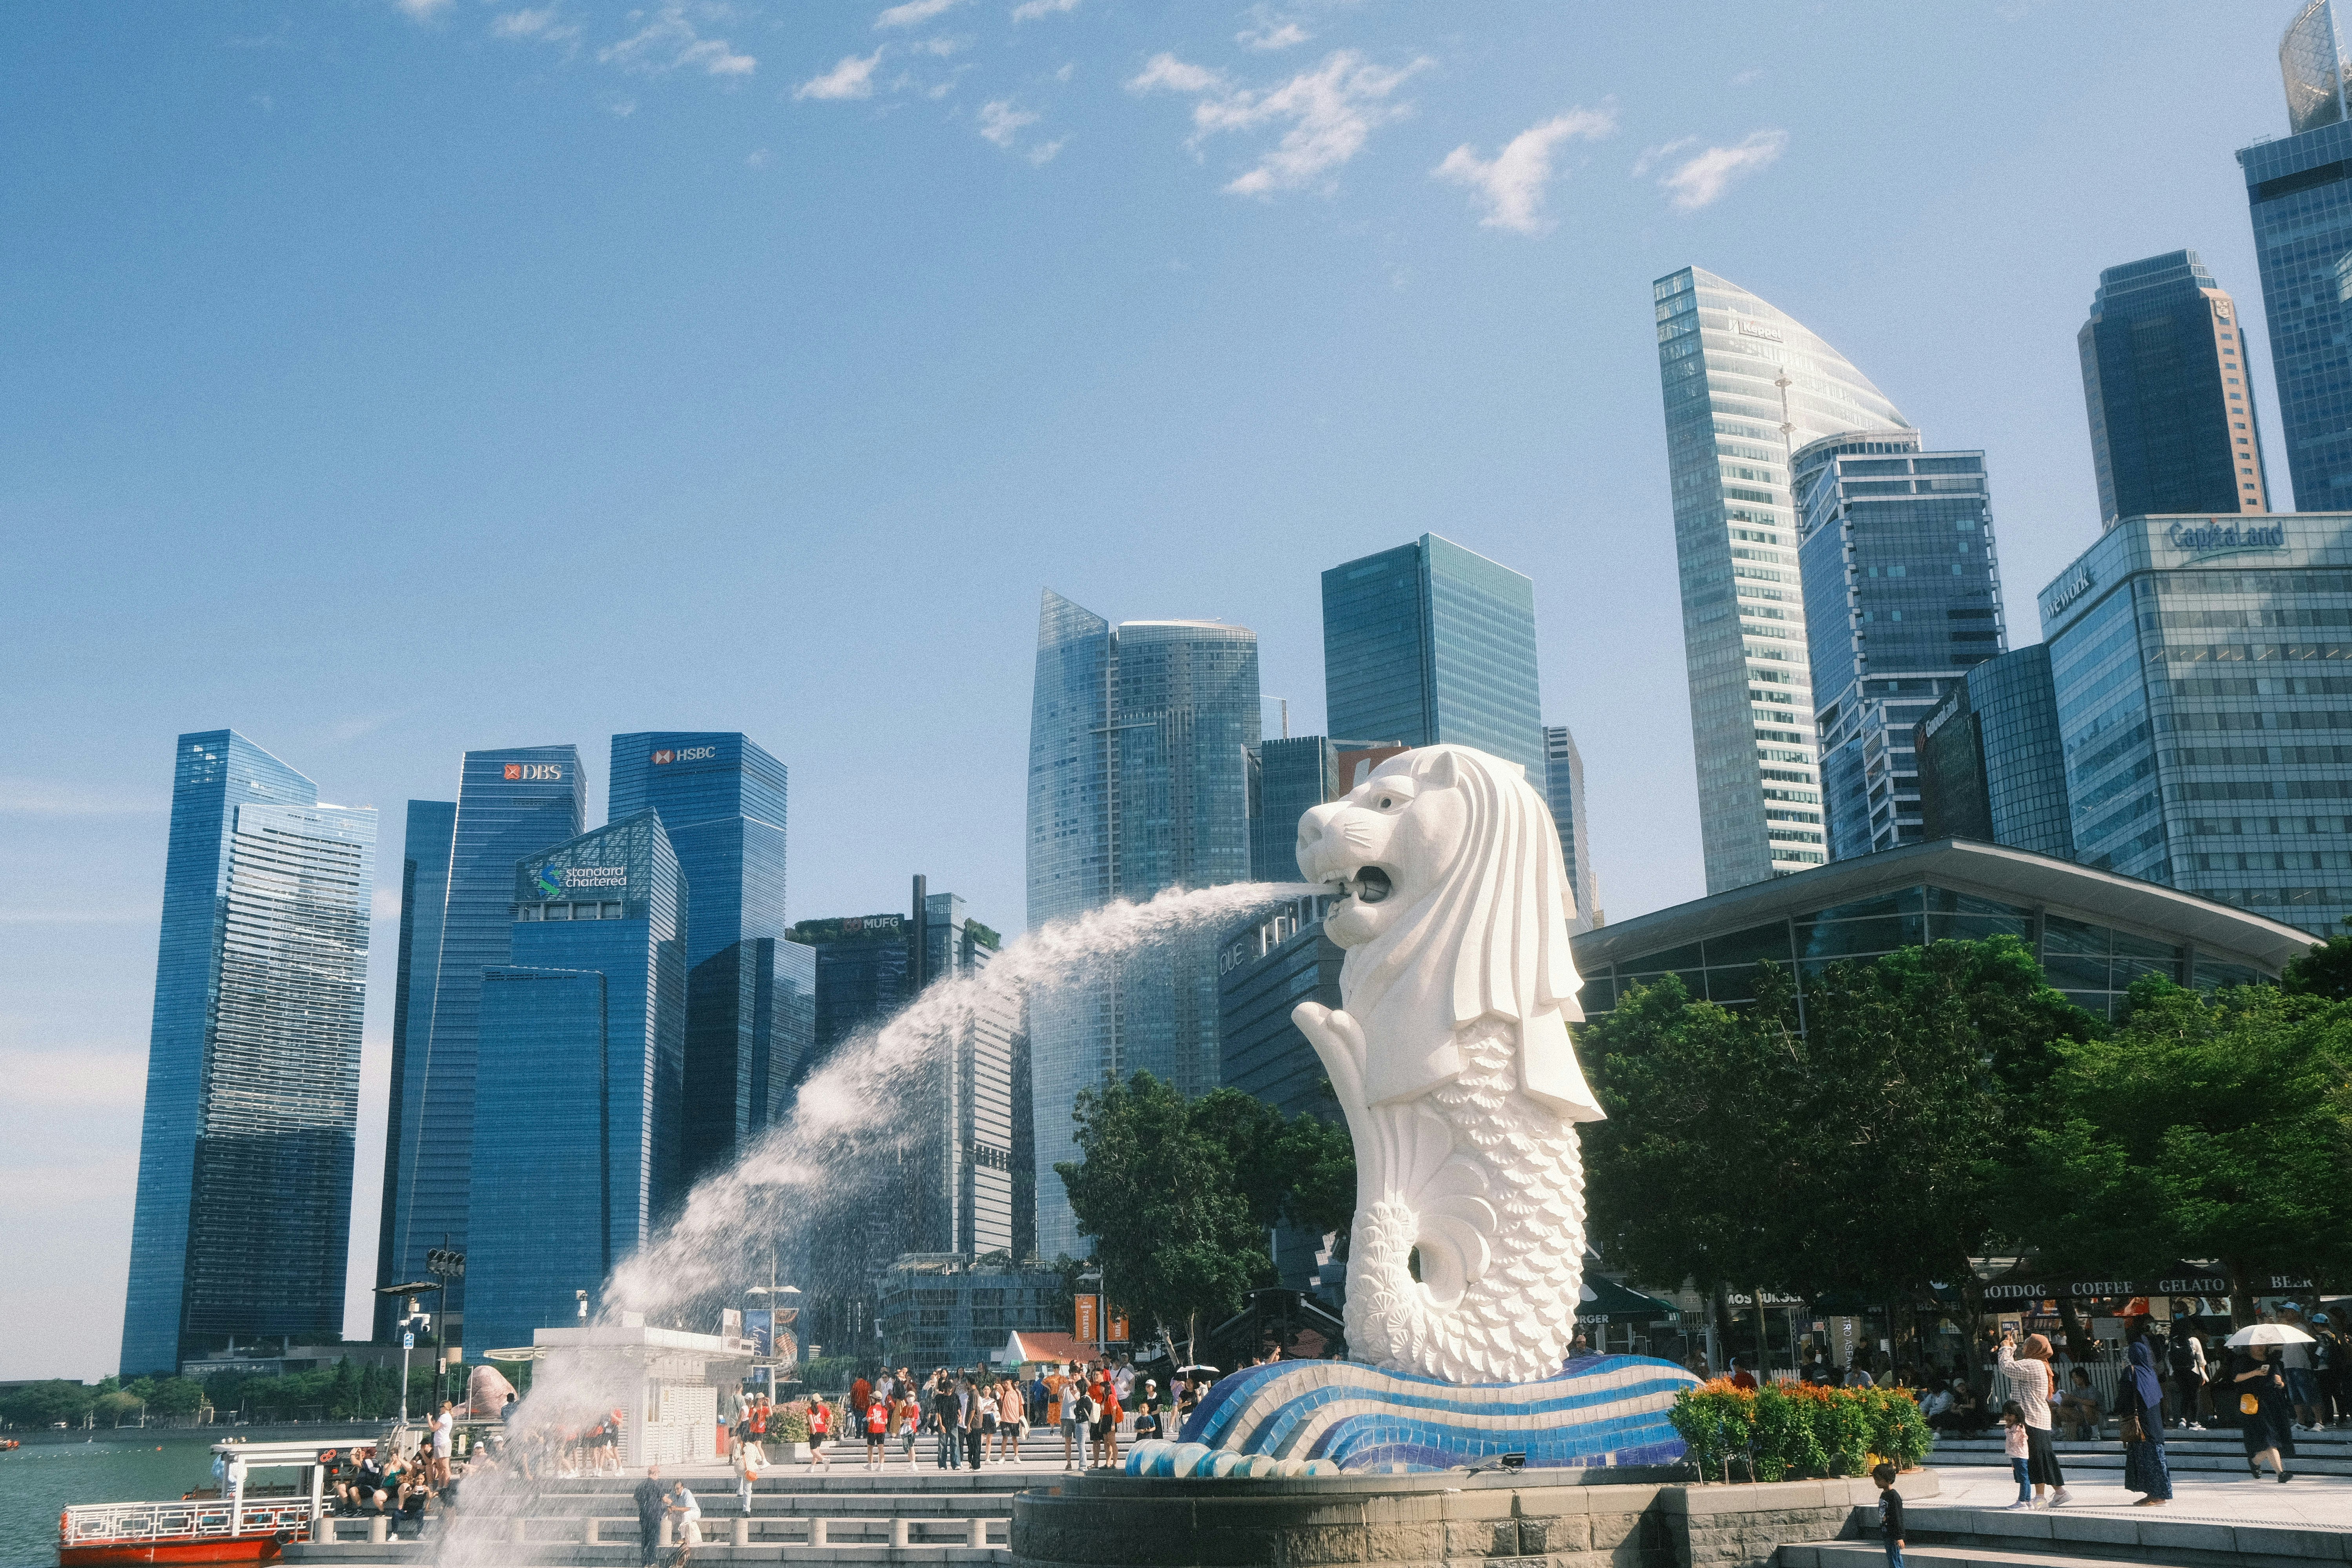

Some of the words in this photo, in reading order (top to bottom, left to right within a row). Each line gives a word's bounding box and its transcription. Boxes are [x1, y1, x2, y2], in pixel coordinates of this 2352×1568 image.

[1743, 320, 1782, 339] Keppel
[2170, 516, 2285, 552] CapitaLand
[2047, 566, 2089, 619] wework
[676, 746, 716, 762] HSBC
[523, 764, 562, 779] DBS
[566, 866, 624, 877] standard
[566, 875, 627, 888] chartered
[864, 917, 899, 929] MUFG
[1220, 943, 1243, 976] OUE
[2071, 1281, 2133, 1295] COFFEE
[2159, 1278, 2225, 1293] GELATO
[1576, 1314, 1609, 1324] RGER
